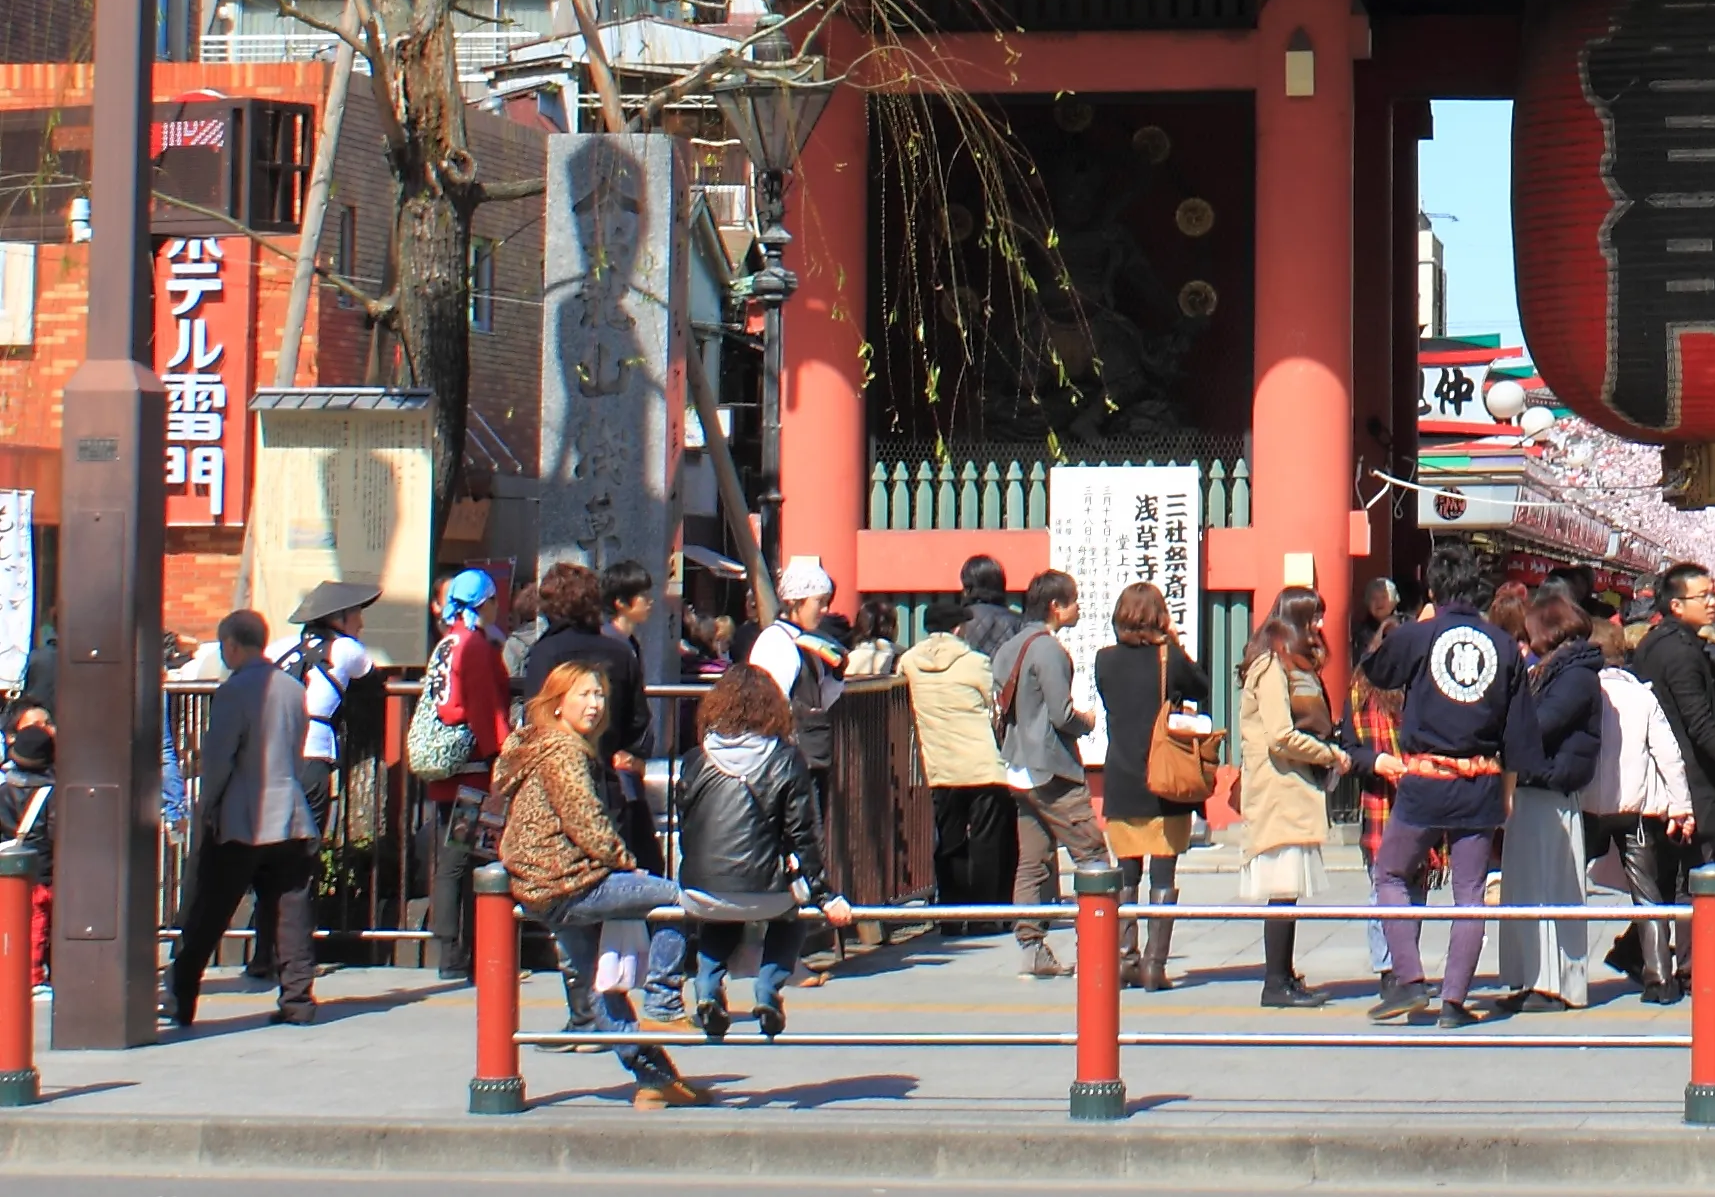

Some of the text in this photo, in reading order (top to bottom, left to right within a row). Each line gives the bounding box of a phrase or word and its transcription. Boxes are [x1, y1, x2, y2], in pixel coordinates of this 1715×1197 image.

[1165, 493, 1188, 638] 三社祭斎行
